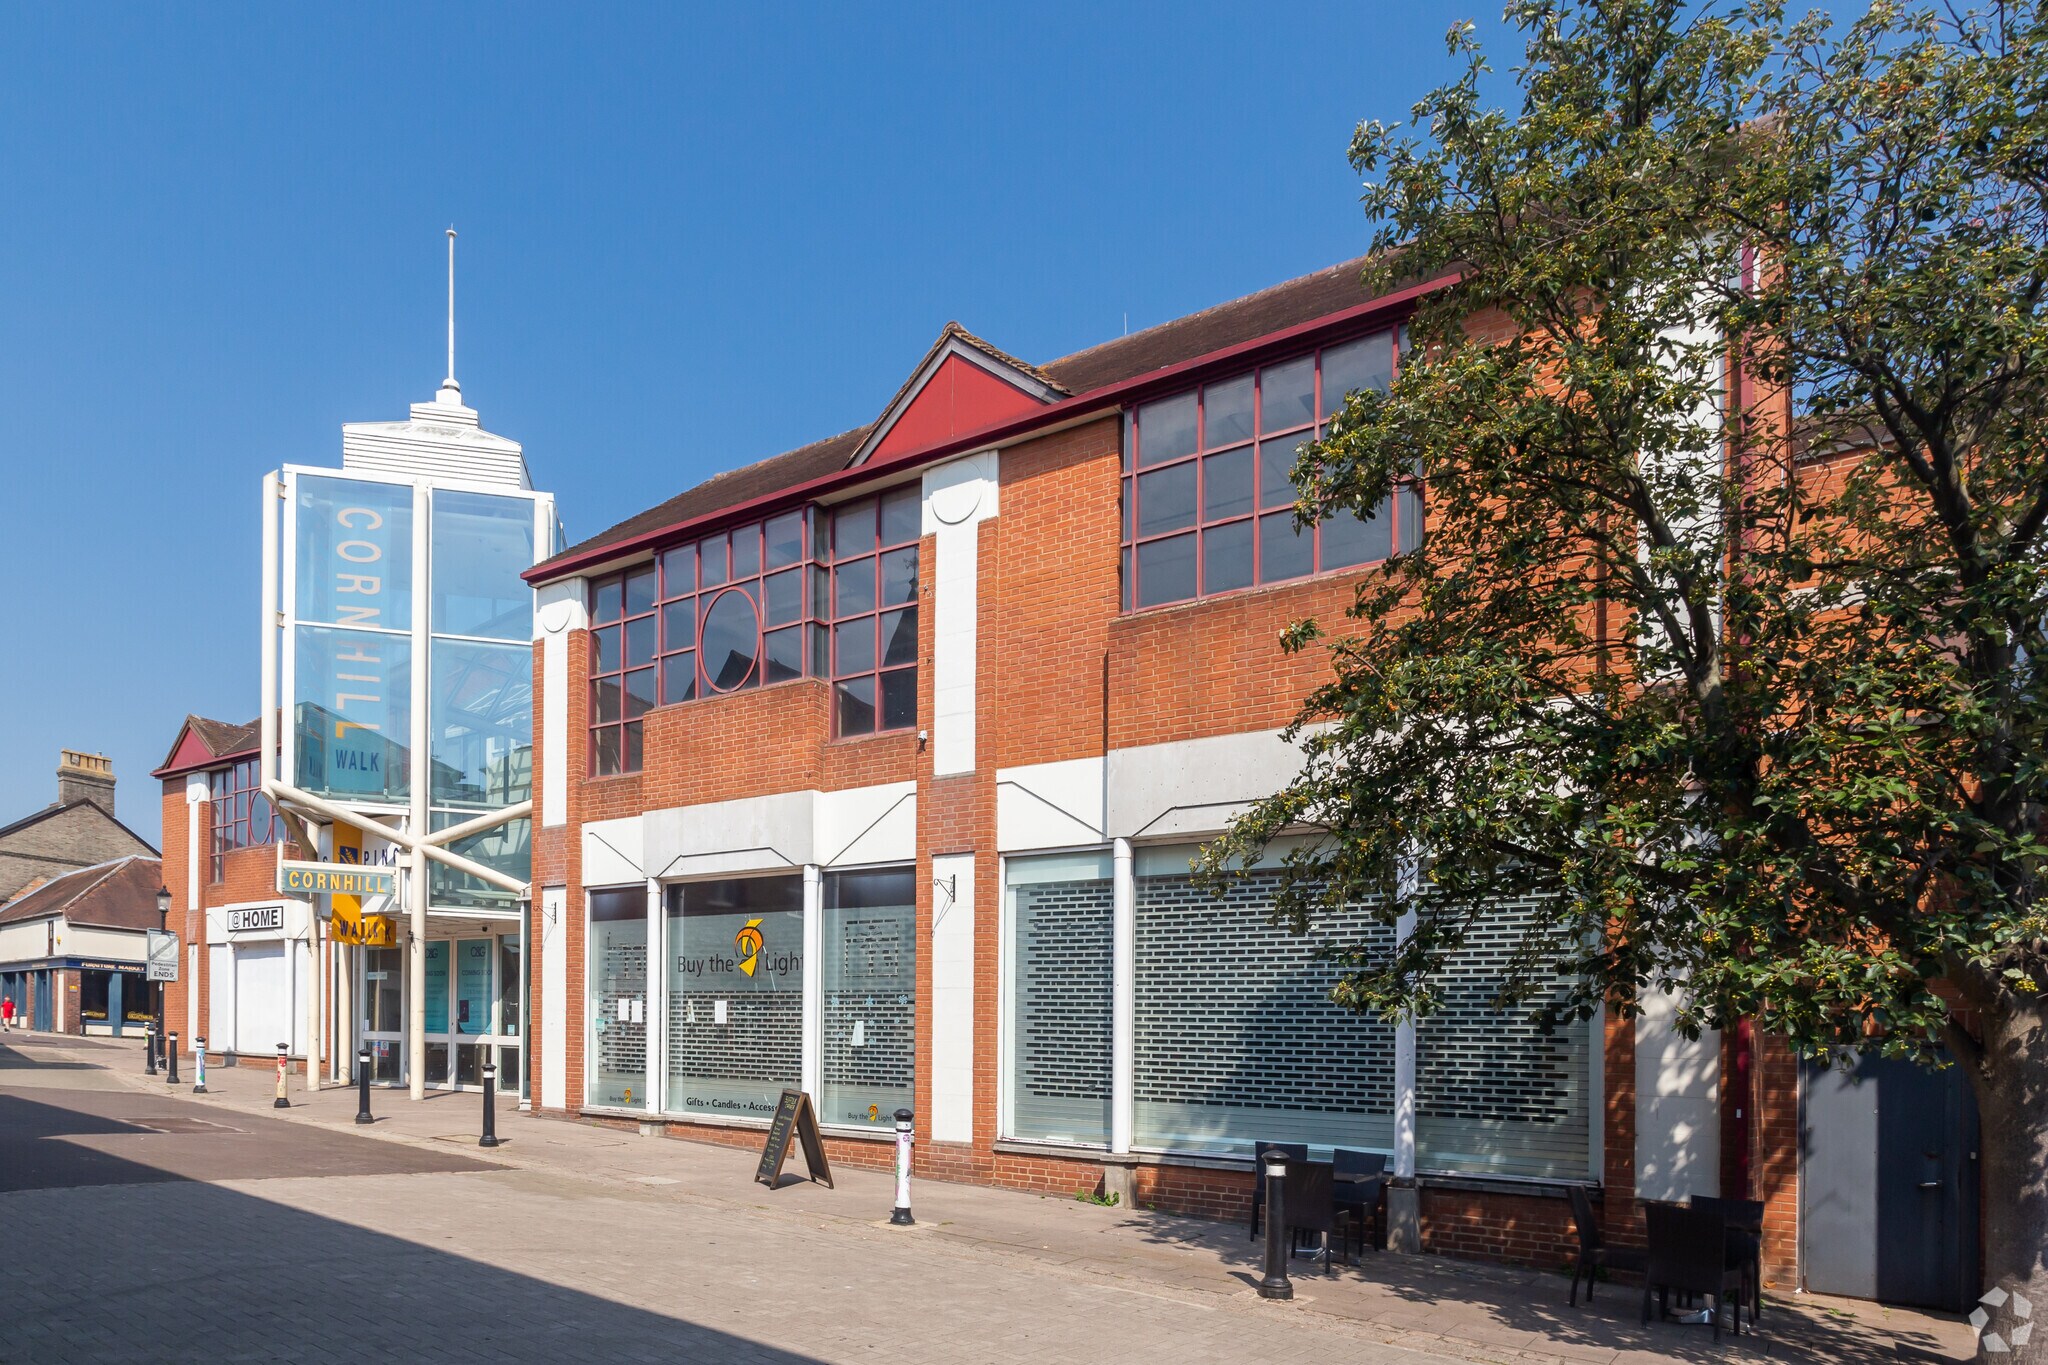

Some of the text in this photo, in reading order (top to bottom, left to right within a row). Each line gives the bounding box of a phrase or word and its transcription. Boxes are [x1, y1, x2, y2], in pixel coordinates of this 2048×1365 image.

[336, 507, 383, 739] CORNHILL
[336, 749, 380, 772] WALK
[289, 870, 385, 893] CORNHILL
[232, 909, 278, 928] @ HOME
[81, 961, 145, 972] FURNITURE MARKET
[678, 956, 704, 977] Buy
[709, 954, 734, 972] the
[686, 1097, 704, 1107] Gifts
[712, 1099, 741, 1109] Candles
[847, 1112, 893, 1122] Buy the Light
